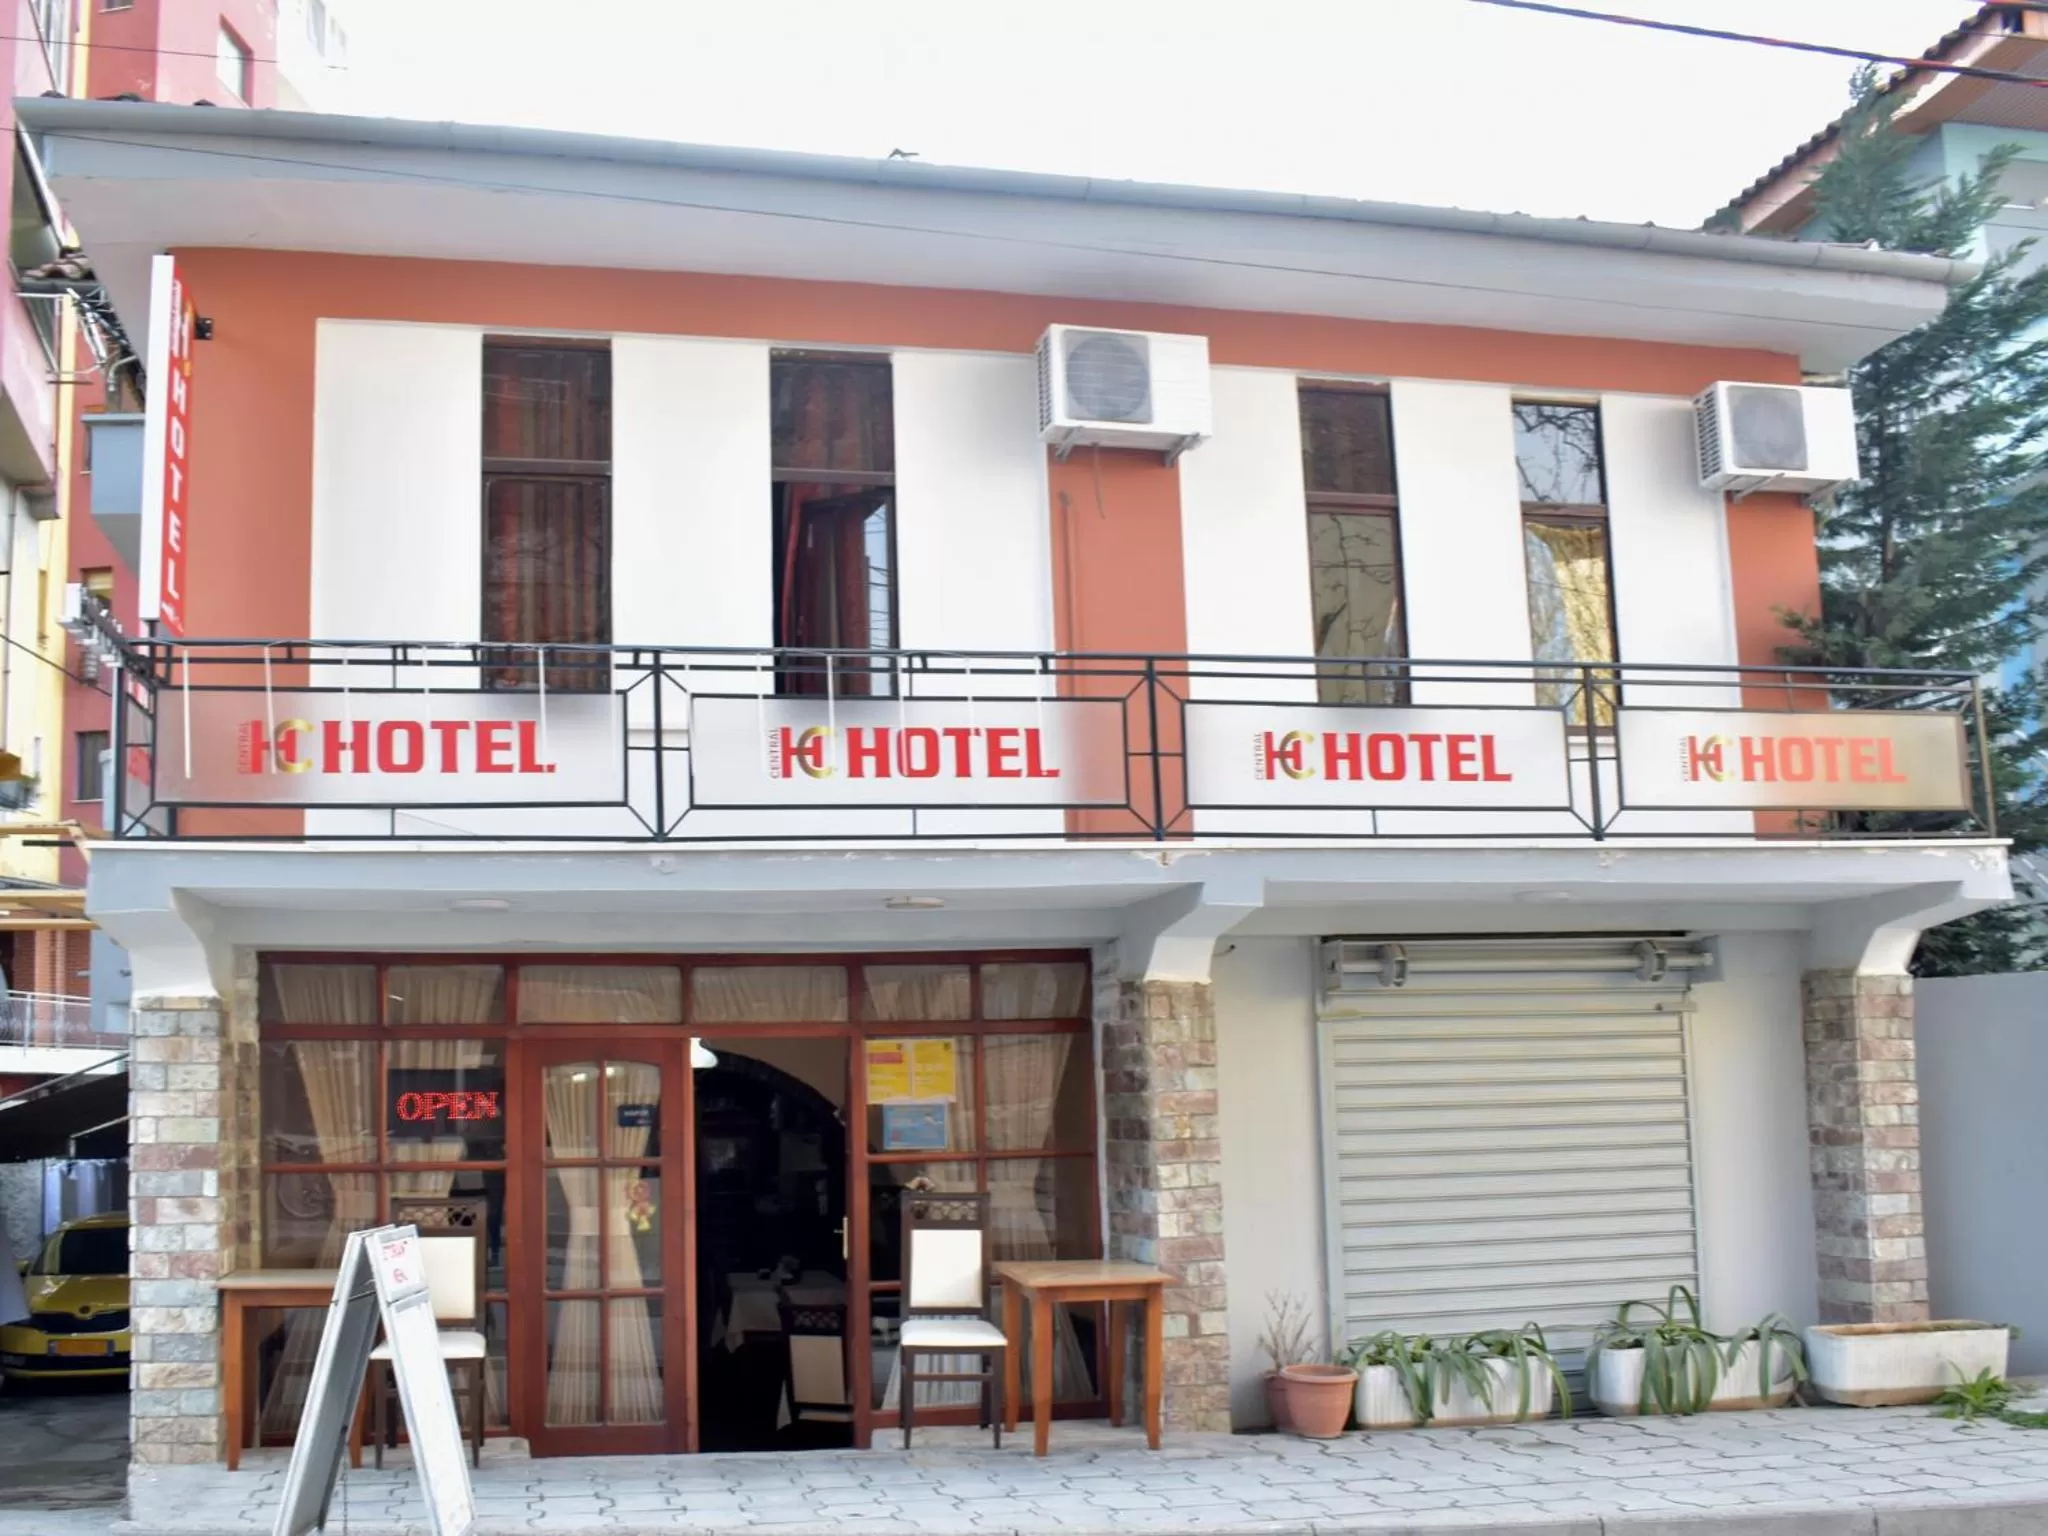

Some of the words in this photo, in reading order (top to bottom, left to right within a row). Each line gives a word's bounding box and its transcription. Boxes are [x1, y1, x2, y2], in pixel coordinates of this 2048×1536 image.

[166, 368, 188, 600] HOTEL
[321, 720, 556, 774] HOTEL
[845, 726, 1061, 778] HOTEL
[1322, 732, 1513, 782] HOTEL
[1739, 736, 1908, 783] HOTEL
[396, 1092, 498, 1120] OPEN
